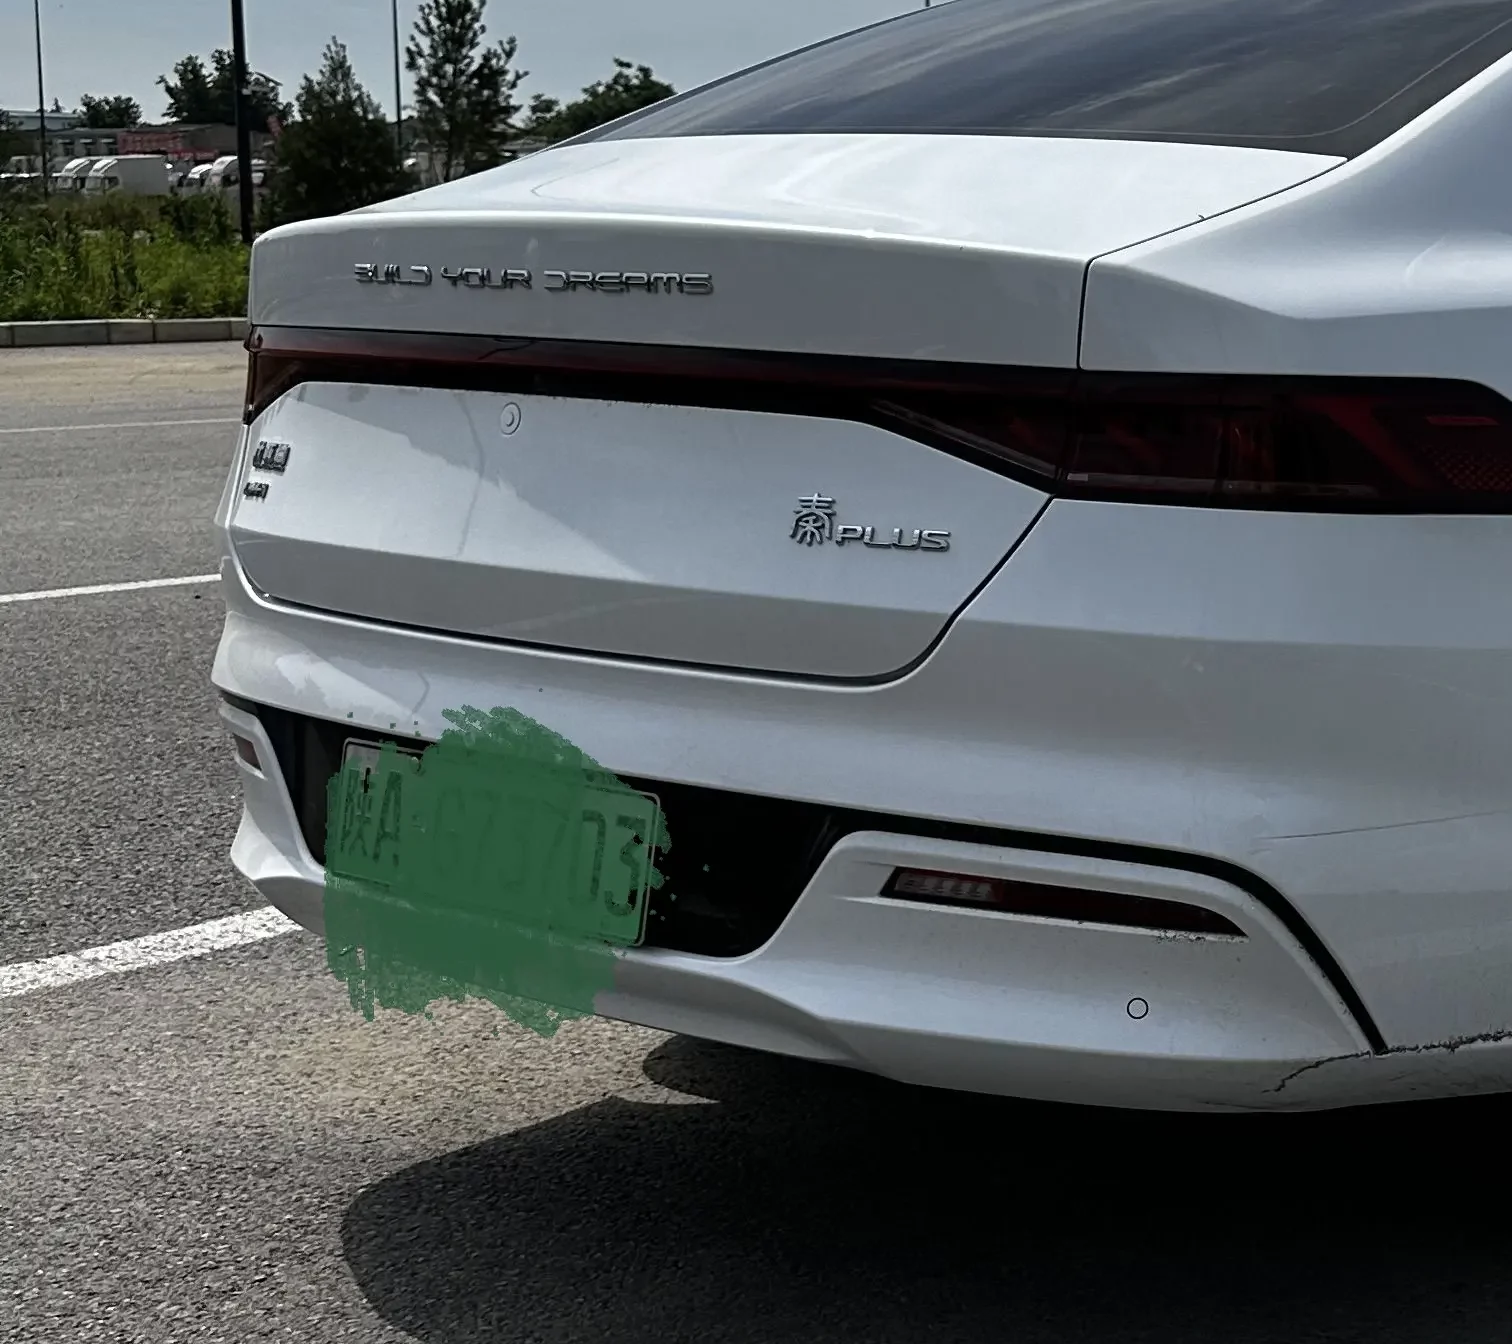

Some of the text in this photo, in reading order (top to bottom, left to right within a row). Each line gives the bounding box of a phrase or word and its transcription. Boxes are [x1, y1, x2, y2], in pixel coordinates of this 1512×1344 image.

[354, 262, 714, 296] BUILD YOUR DREAMS
[835, 524, 951, 553] PLUS
